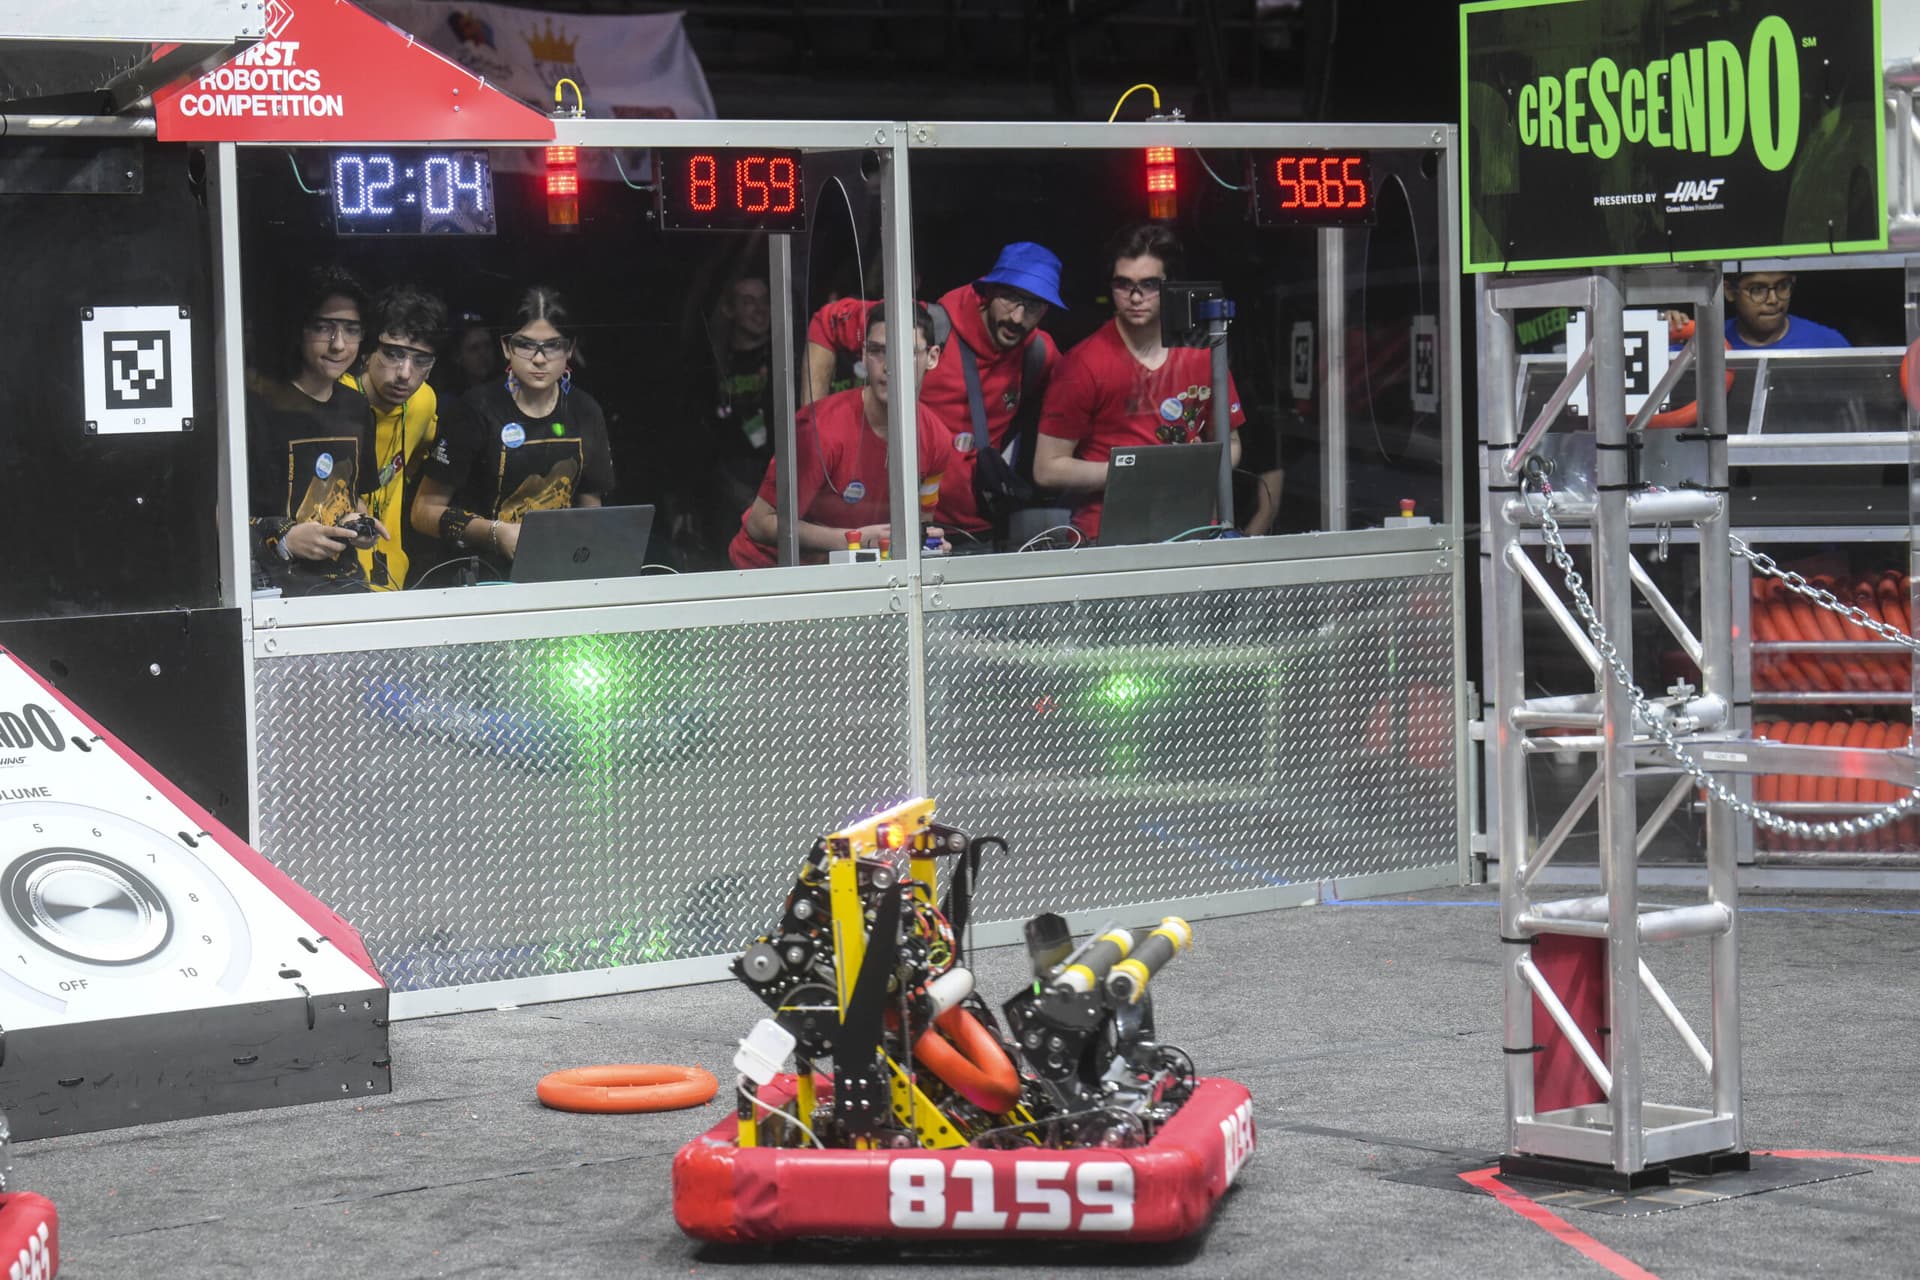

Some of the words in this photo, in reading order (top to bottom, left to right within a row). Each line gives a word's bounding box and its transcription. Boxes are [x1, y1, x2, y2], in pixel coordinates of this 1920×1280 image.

[200, 68, 321, 91] ROBOTICS
[1518, 15, 1800, 171] CRESCENDO
[1802, 36, 1817, 48] SM
[179, 94, 344, 117] COMPETITION
[336, 156, 483, 214] 02:04
[1276, 157, 1366, 208] 5665
[1664, 178, 1725, 202] HAAS
[1594, 193, 1644, 206] PRESENTED
[1645, 193, 1656, 203] BY
[33, 823, 44, 833] 5
[92, 828, 102, 838] 6
[147, 853, 157, 864] 7
[188, 893, 200, 903] 8
[202, 935, 213, 945] 9
[18, 955, 28, 966] 1
[179, 967, 199, 979] 10
[58, 979, 89, 992] OFF
[889, 1158, 1135, 1231] 8159
